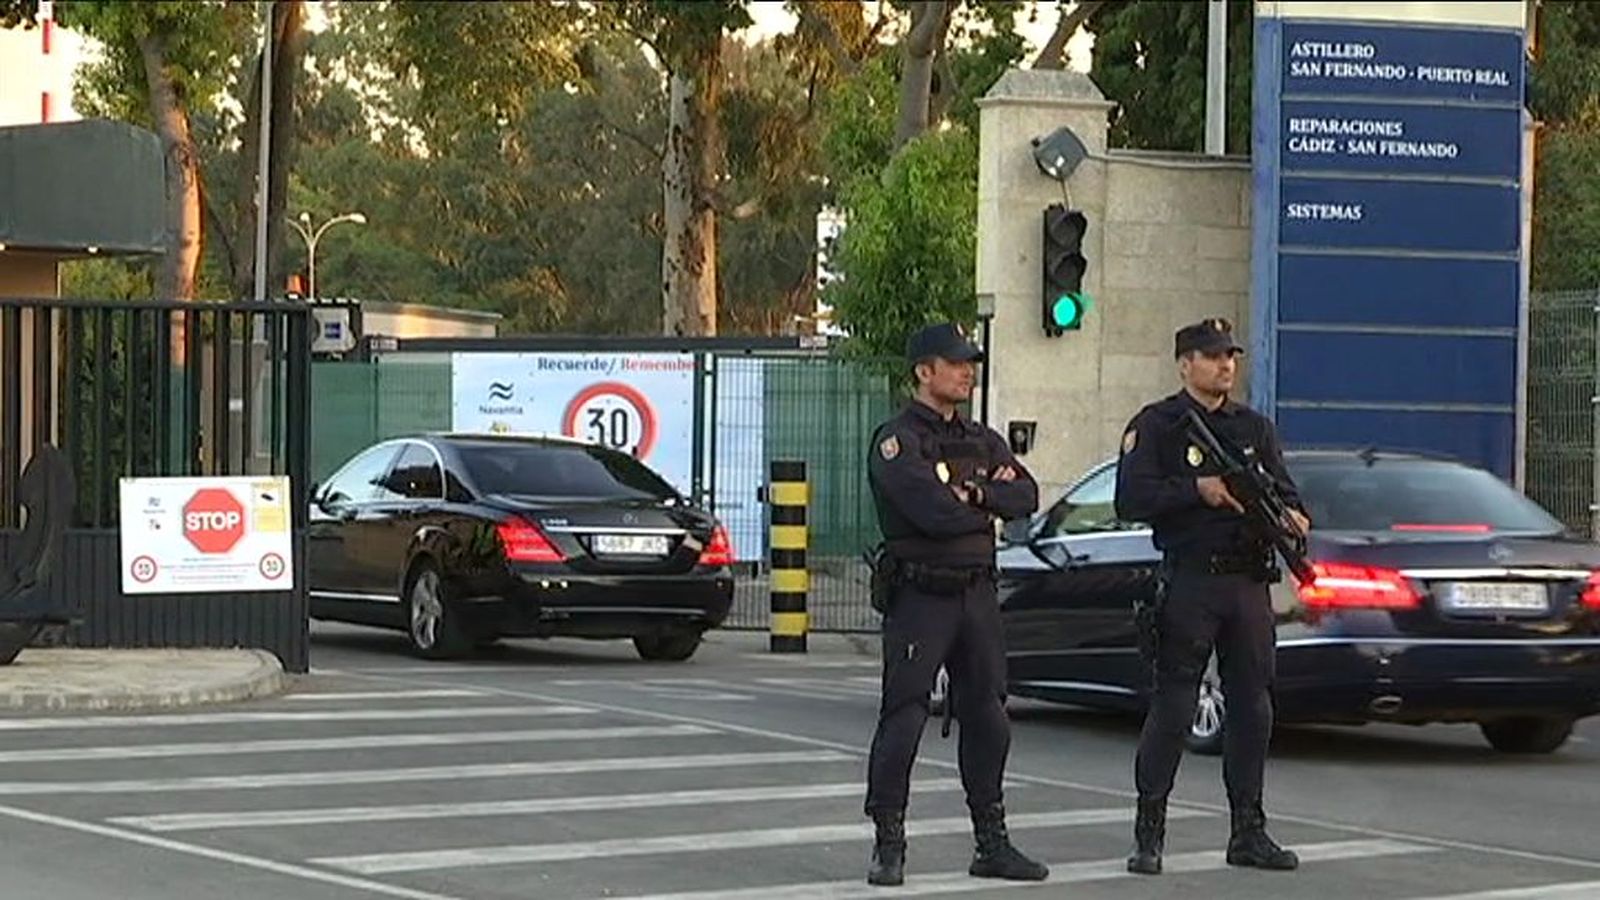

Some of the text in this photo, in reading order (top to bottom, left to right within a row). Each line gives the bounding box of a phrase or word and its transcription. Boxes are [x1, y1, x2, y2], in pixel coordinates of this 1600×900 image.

[1291, 42, 1375, 58] ASTILLERO
[1290, 61, 1322, 77] SAN
[1325, 62, 1406, 79] FERNANDO
[1417, 66, 1474, 84] PUERTO
[1476, 71, 1509, 86] REAL
[1289, 118, 1403, 135] REPARACIONES
[1347, 140, 1377, 155] SAN
[1380, 141, 1458, 158] FERNANDO
[1287, 204, 1362, 220] SISTEMAS
[621, 357, 695, 372] Remembe
[587, 408, 628, 449] 30
[186, 512, 241, 531] STOP
